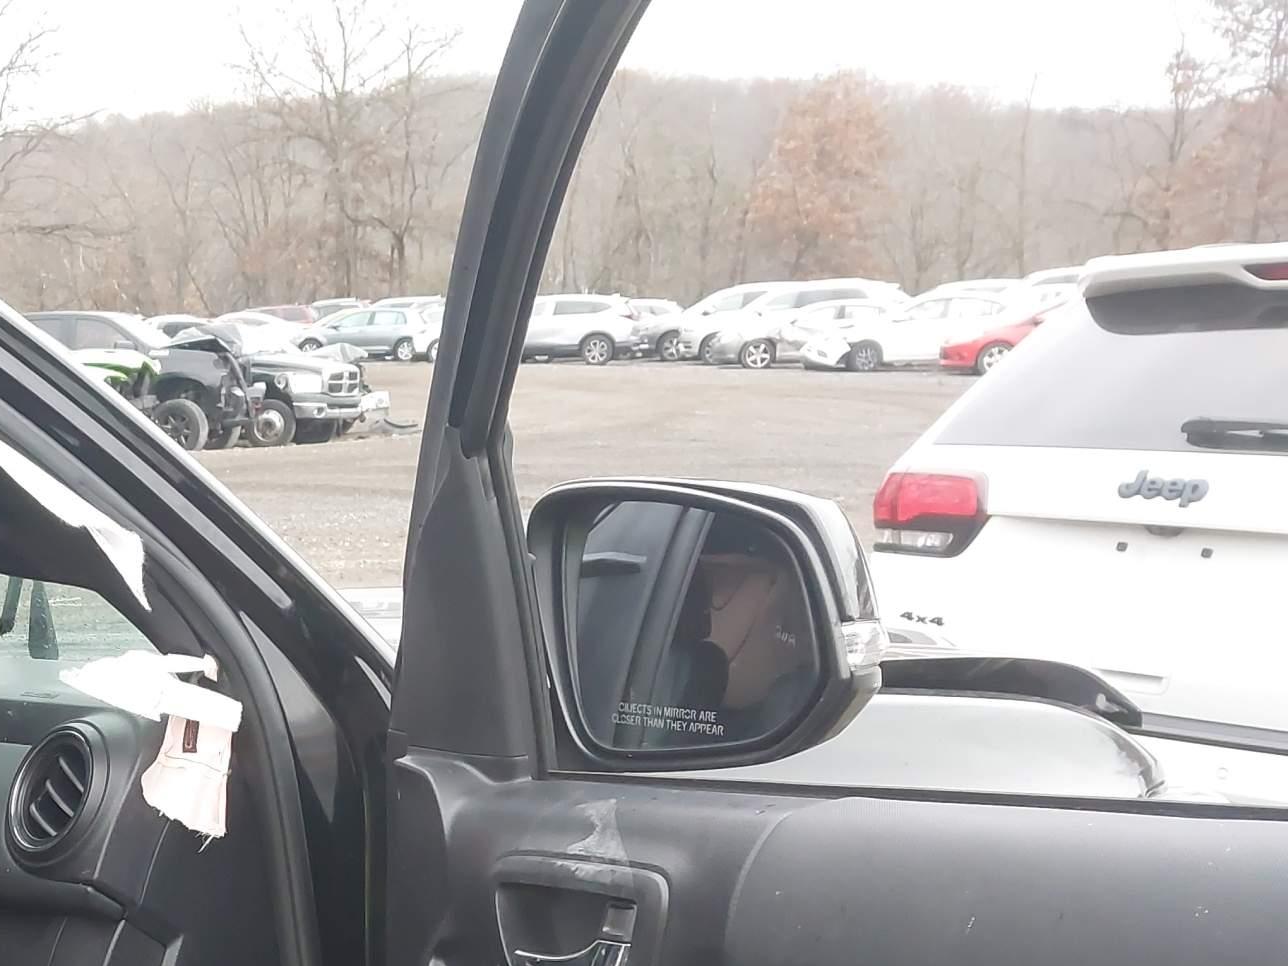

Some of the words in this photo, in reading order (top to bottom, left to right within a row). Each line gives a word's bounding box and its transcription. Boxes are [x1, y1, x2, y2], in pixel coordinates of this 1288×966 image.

[1118, 469, 1210, 508] Jeep
[899, 611, 945, 626] 4x4
[653, 706, 663, 717] IN
[663, 706, 697, 721] MIRROR
[698, 710, 717, 723] ARE
[611, 713, 642, 726] CLOSER
[642, 716, 665, 729] THAN
[665, 719, 688, 732] THEY
[688, 722, 724, 737] APPEAR
